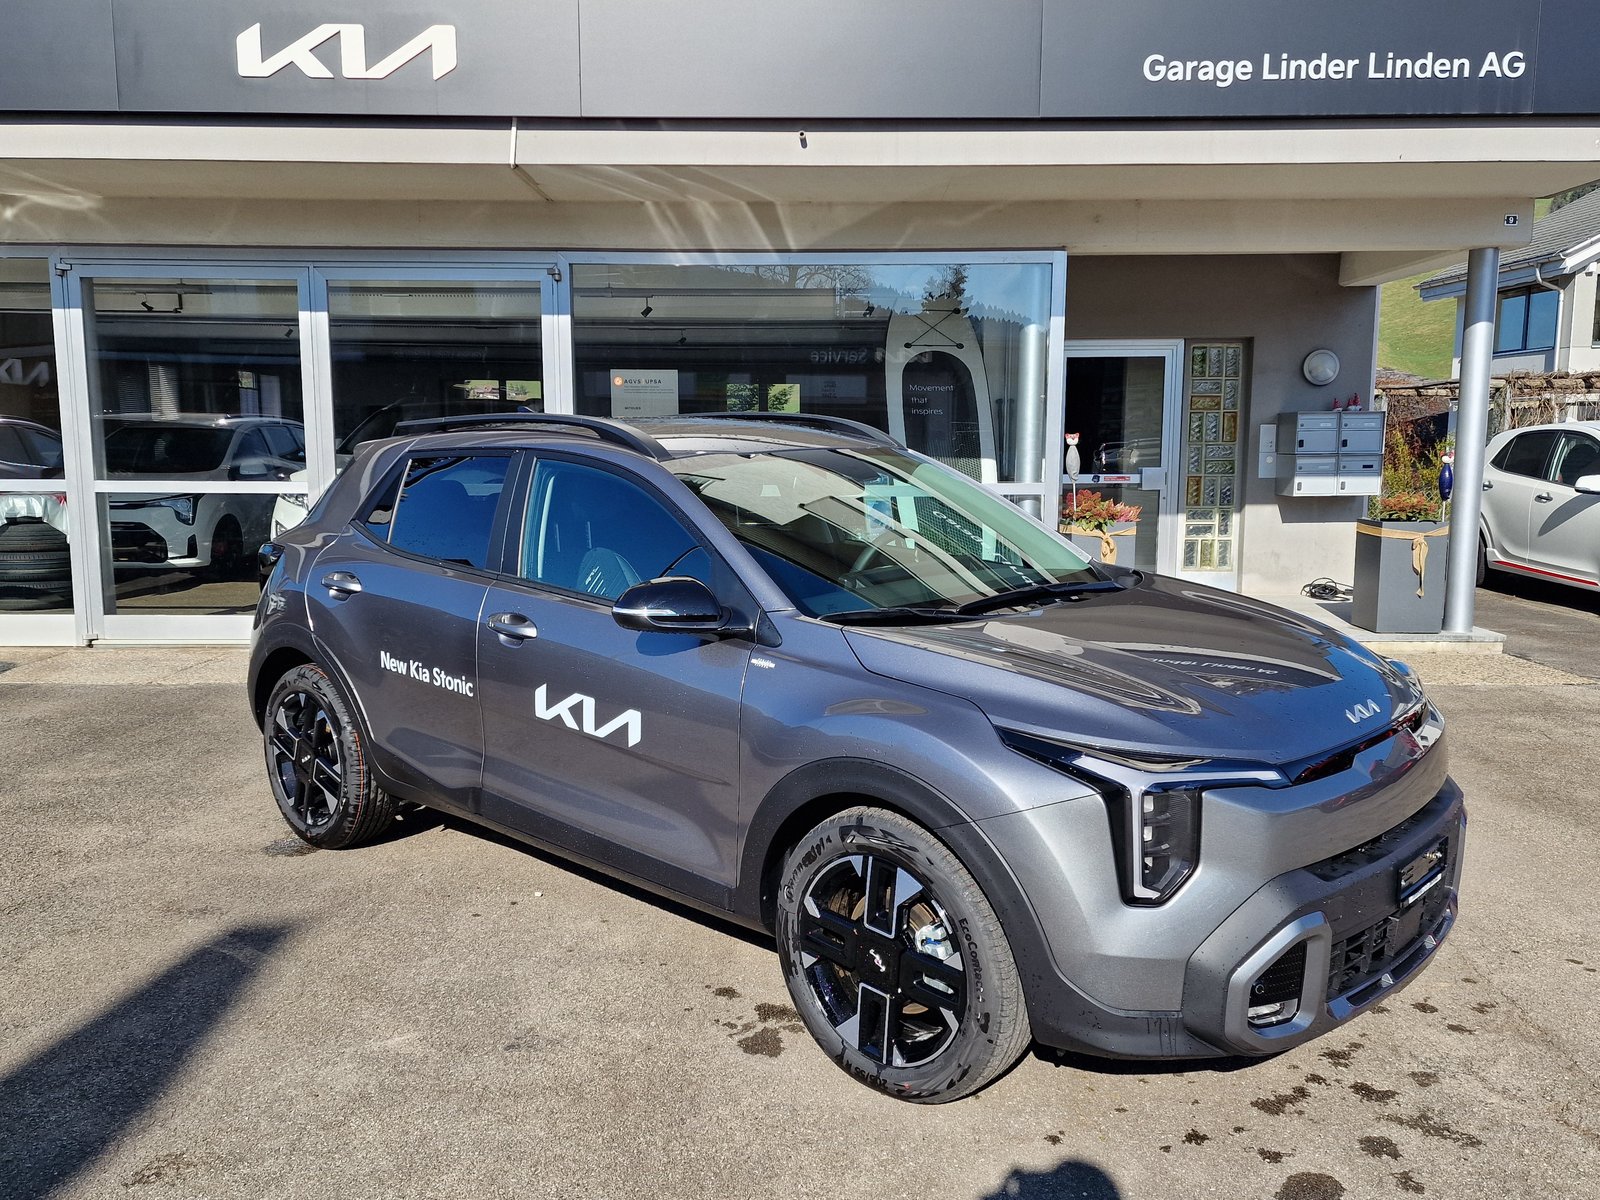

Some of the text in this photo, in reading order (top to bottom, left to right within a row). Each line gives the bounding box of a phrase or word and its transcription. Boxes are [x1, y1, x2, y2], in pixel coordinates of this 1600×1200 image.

[236, 22, 458, 81] KIA
[1142, 51, 1526, 87] Garage Linder Linden AG
[909, 383, 954, 392] Movement
[911, 396, 928, 404] that
[911, 407, 943, 415] inspires
[380, 650, 474, 697] New Kia Stonic
[534, 683, 642, 748] KIA
[1345, 698, 1381, 724] KIA
